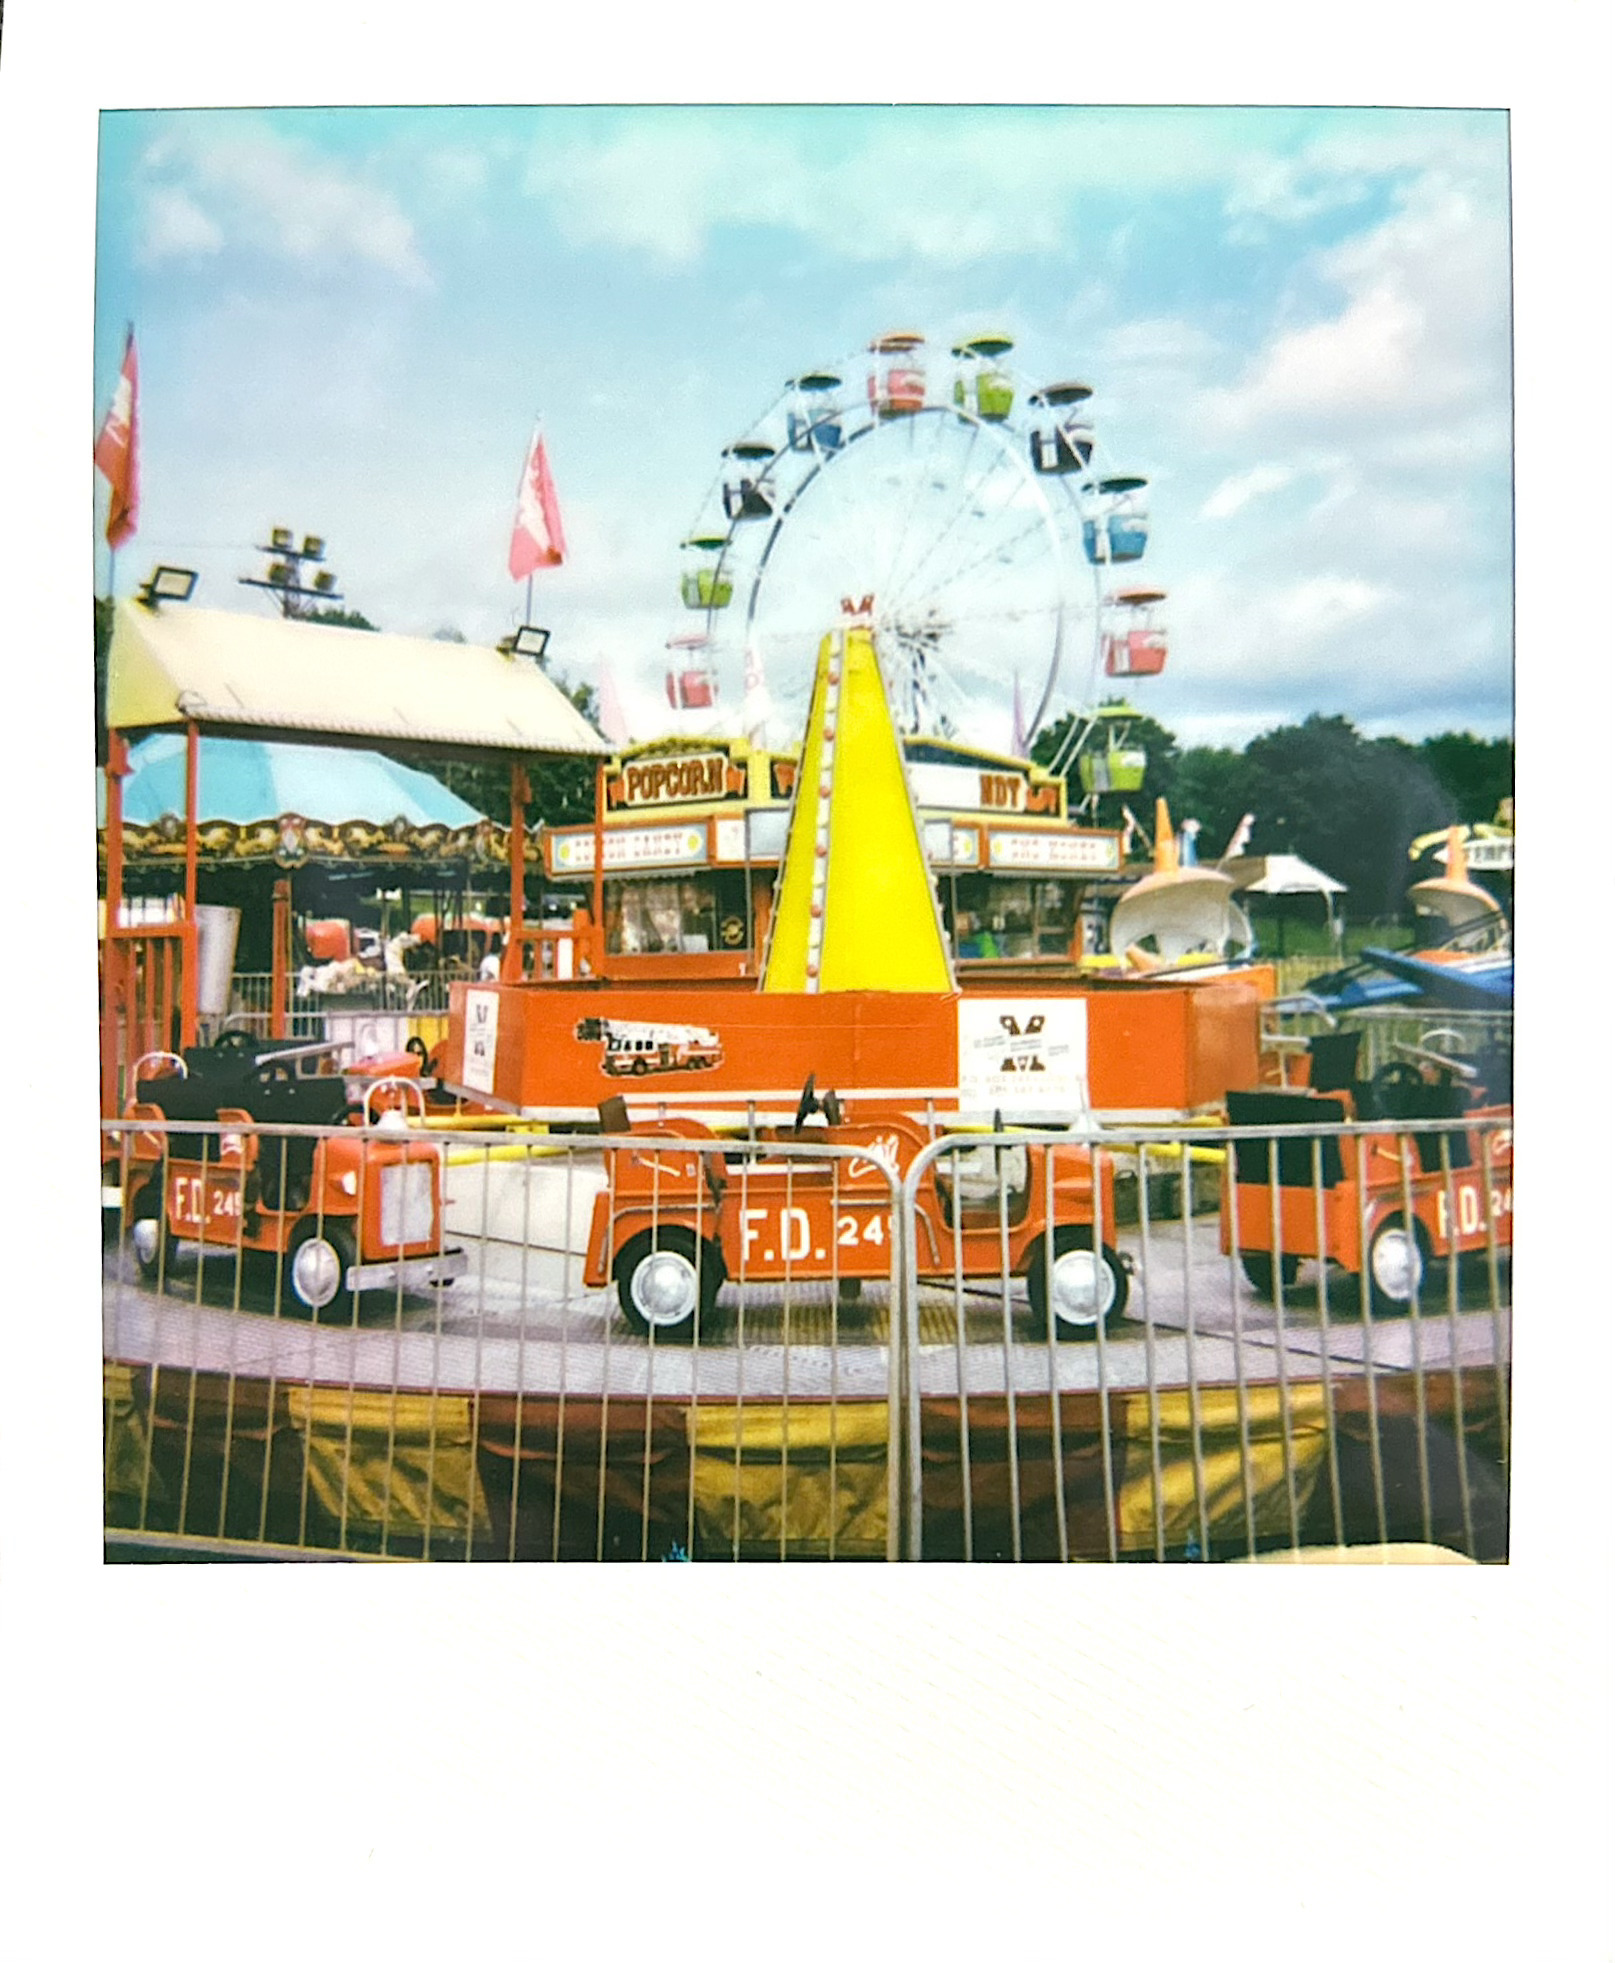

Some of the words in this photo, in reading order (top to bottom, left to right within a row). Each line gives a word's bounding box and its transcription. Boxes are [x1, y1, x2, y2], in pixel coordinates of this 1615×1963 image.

[627, 756, 724, 802] POPCORN
[175, 1176, 212, 1225] F.D.
[739, 1207, 826, 1262] F.D.
[836, 1214, 893, 1246] 24
